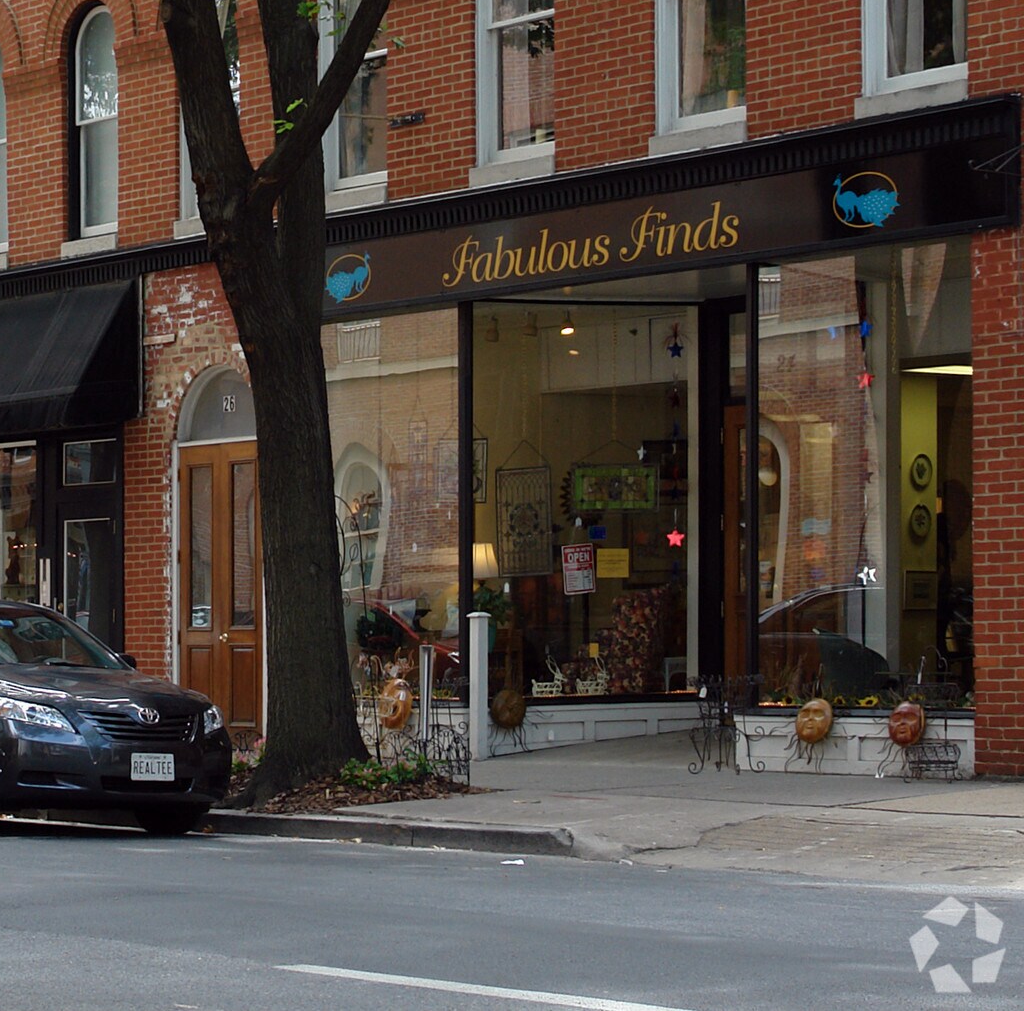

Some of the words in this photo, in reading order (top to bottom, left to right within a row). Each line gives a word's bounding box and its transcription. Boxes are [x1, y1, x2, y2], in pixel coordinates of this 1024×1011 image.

[442, 228, 610, 287] Fabulous
[619, 201, 739, 262] Finds
[223, 396, 235, 412] 26
[567, 552, 590, 563] OPEN
[133, 760, 173, 775] REALTEE
